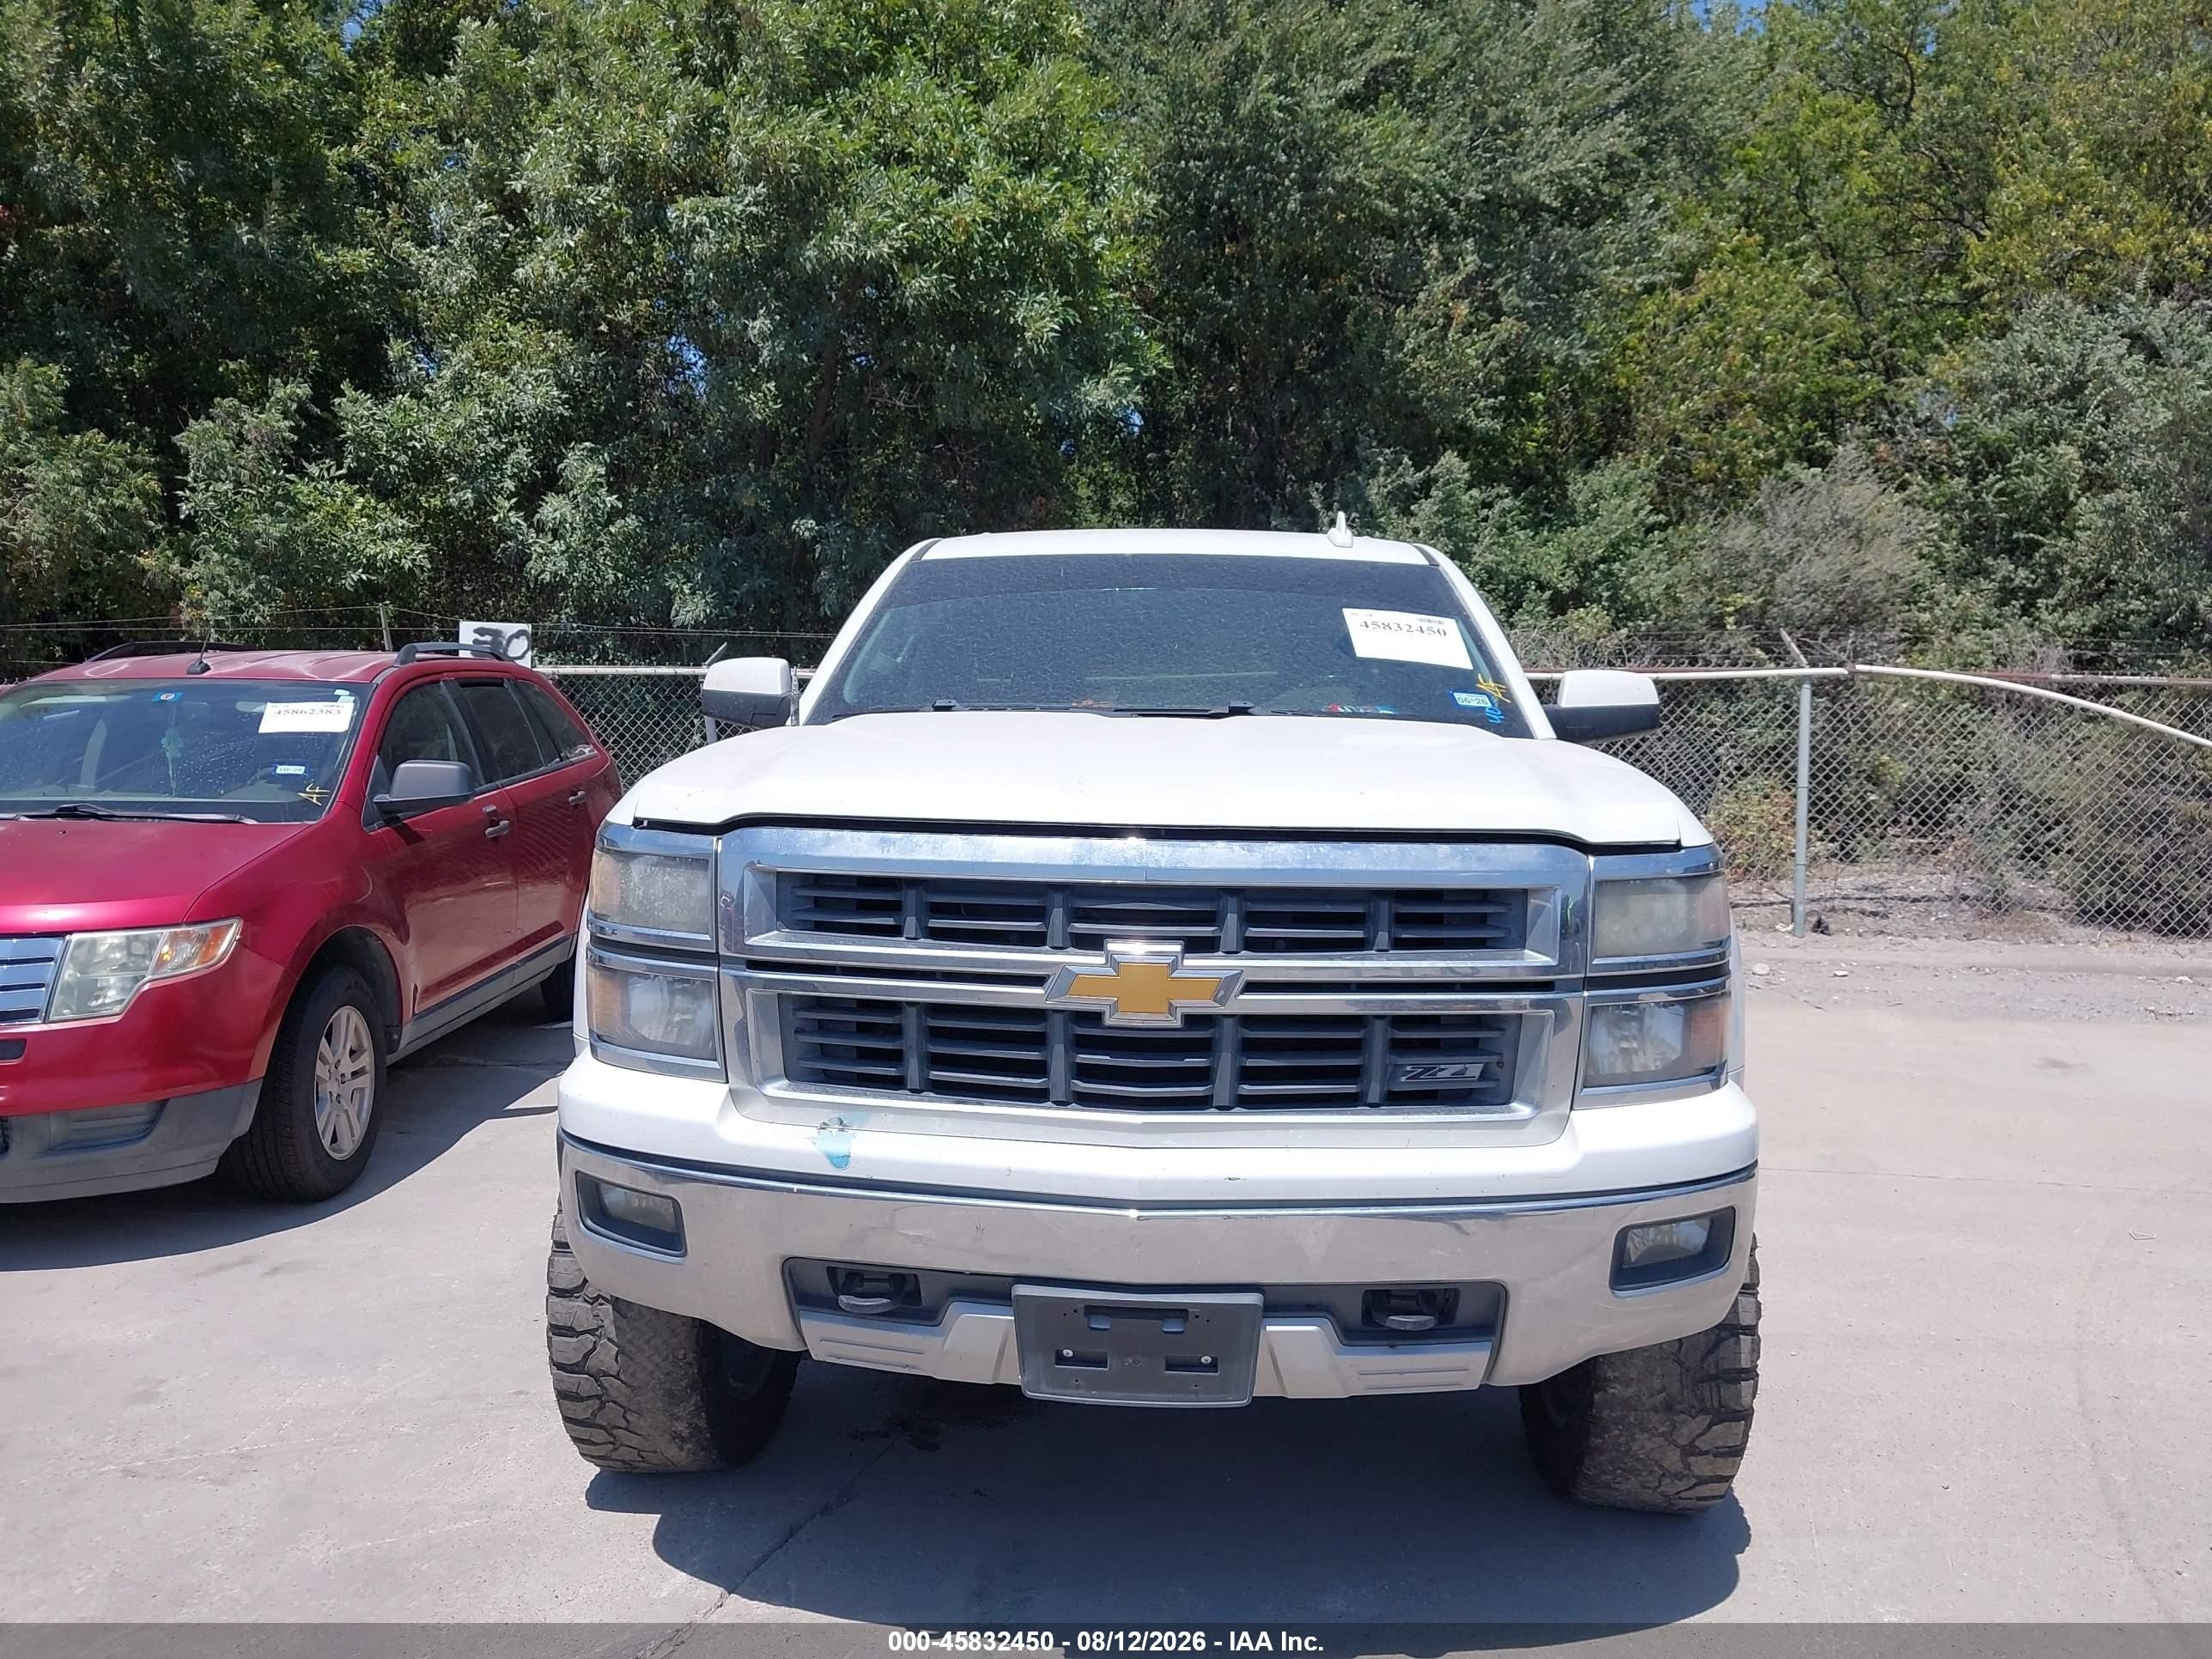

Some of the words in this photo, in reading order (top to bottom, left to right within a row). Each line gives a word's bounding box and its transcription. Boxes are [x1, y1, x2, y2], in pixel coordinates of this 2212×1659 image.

[1359, 620, 1448, 637] 45832450
[471, 626, 531, 661] 30
[297, 782, 331, 806] AF
